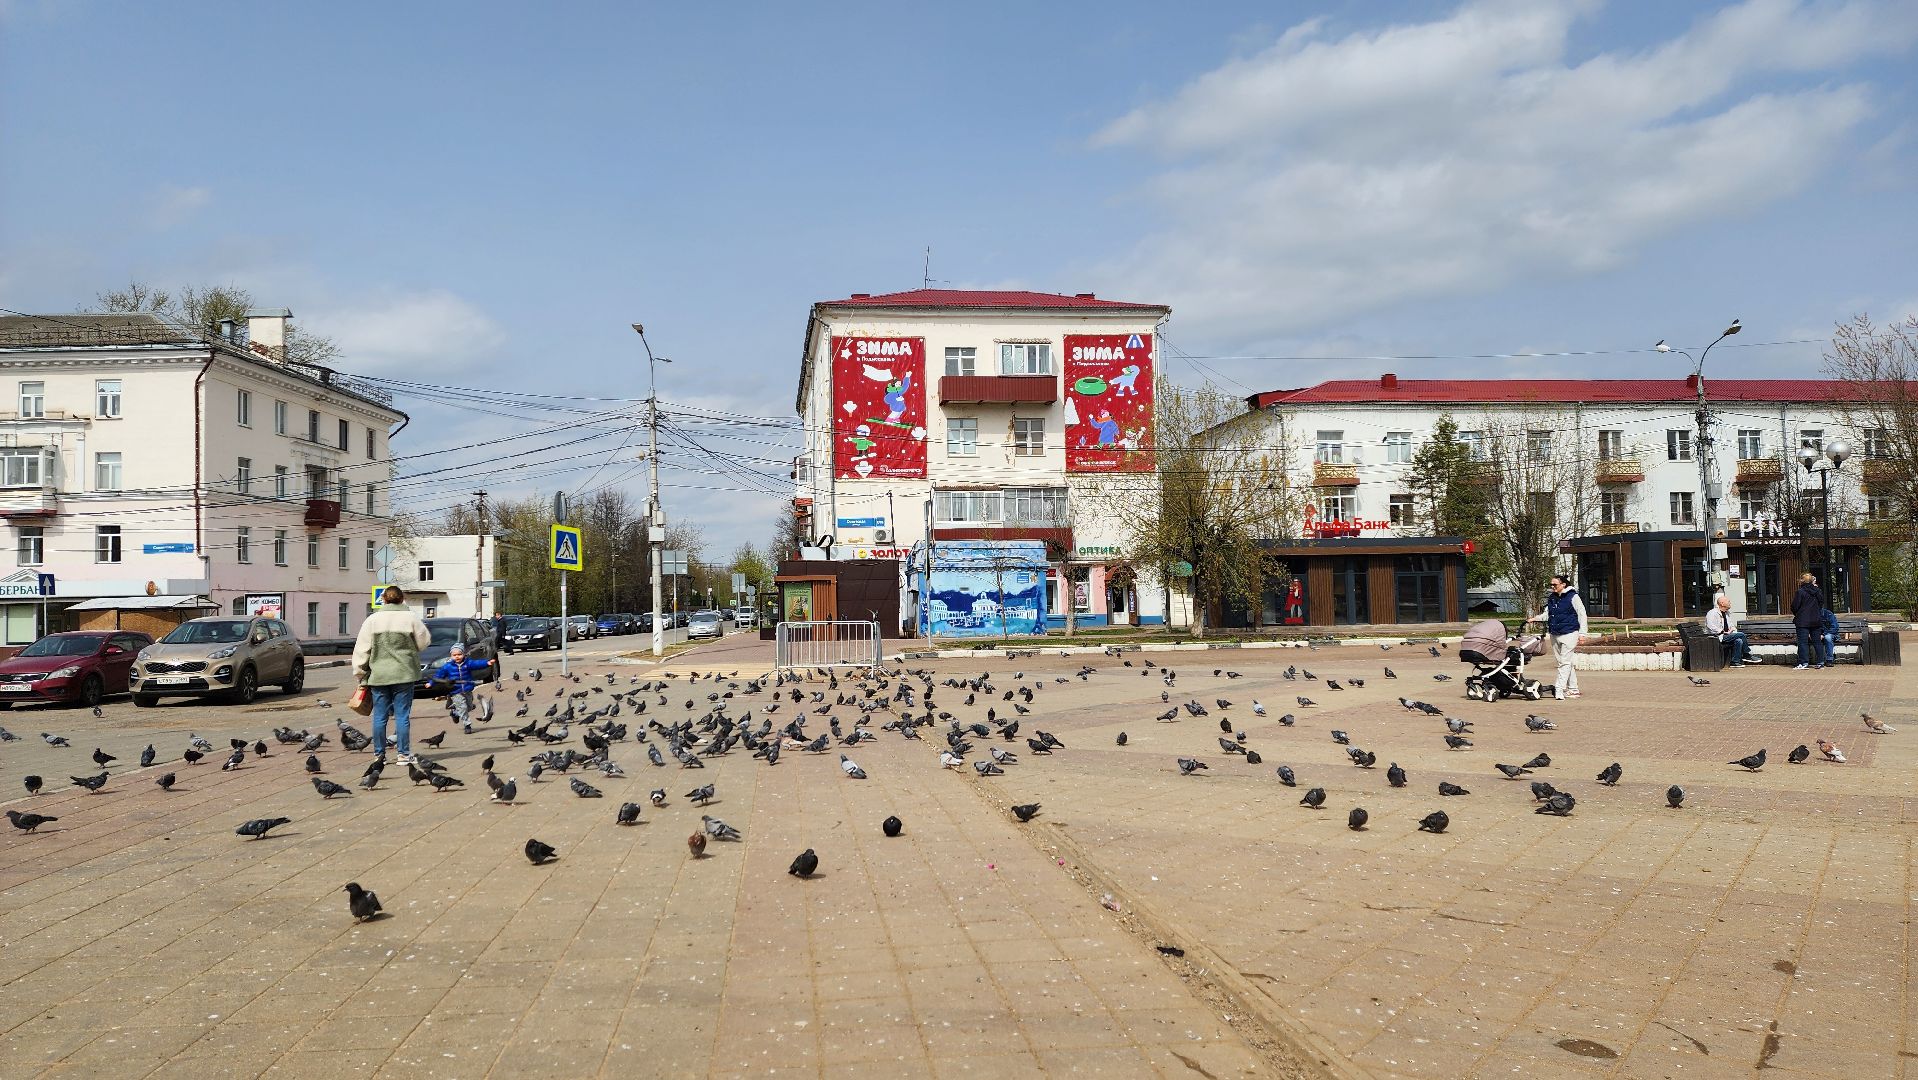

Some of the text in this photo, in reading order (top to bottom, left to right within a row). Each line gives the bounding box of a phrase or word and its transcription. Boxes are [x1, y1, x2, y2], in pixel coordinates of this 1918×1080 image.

[857, 341, 912, 356] ЗИМА
[1072, 346, 1125, 361] ЗИМА
[1354, 518, 1391, 530] Банк
[1079, 546, 1121, 555] ОПТИКА
